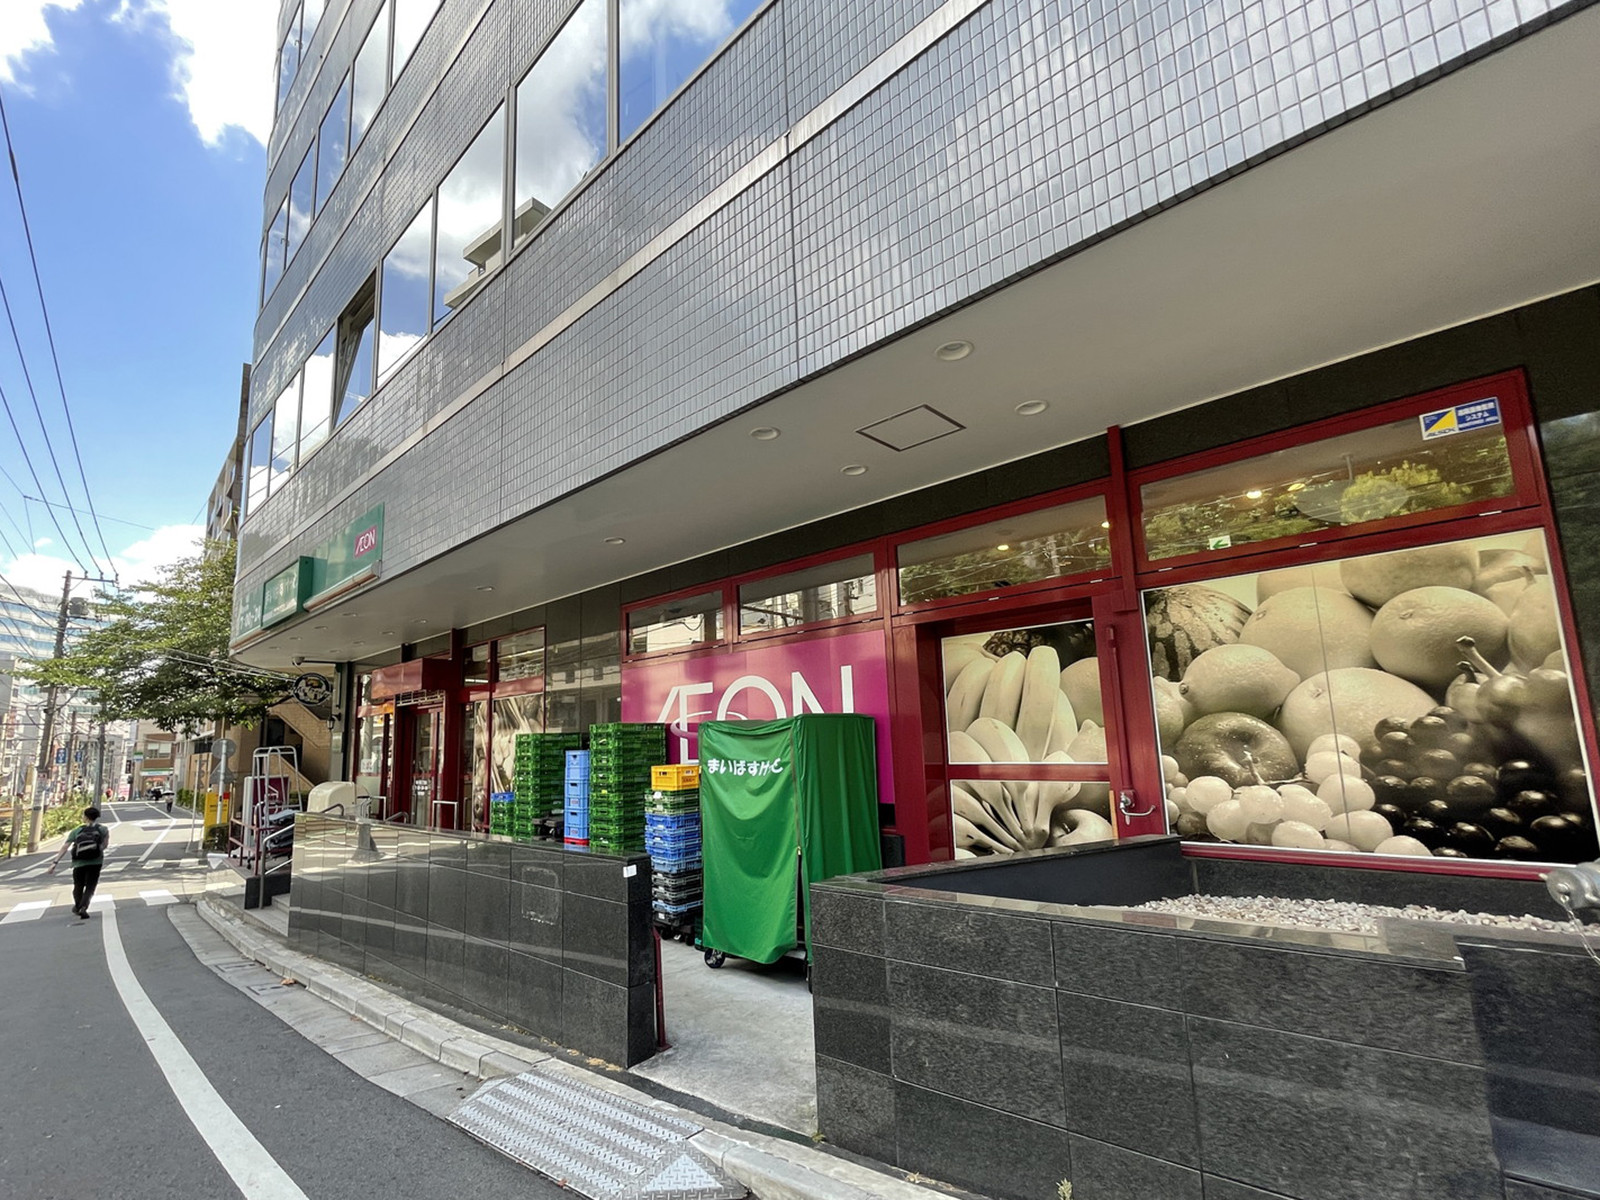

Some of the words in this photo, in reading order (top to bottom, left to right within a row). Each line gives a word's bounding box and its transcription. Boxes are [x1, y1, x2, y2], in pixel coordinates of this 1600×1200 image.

[707, 758, 783, 776] まいばすけと
